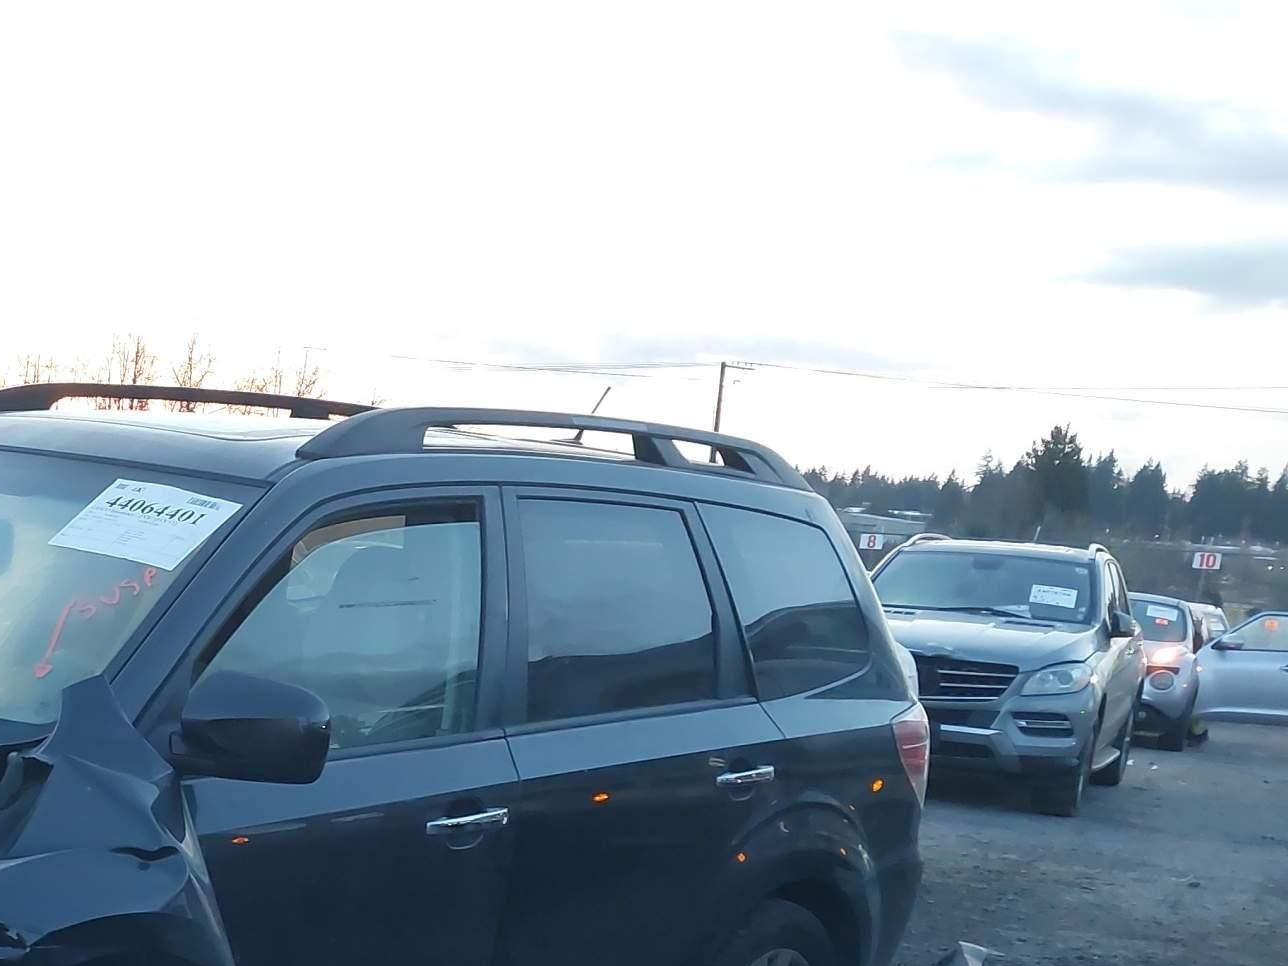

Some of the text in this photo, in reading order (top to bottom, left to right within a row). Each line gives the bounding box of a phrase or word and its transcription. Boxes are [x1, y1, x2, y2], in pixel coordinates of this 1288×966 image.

[105, 495, 208, 526] 44064401
[866, 534, 877, 549] 8
[1199, 553, 1217, 569] 10
